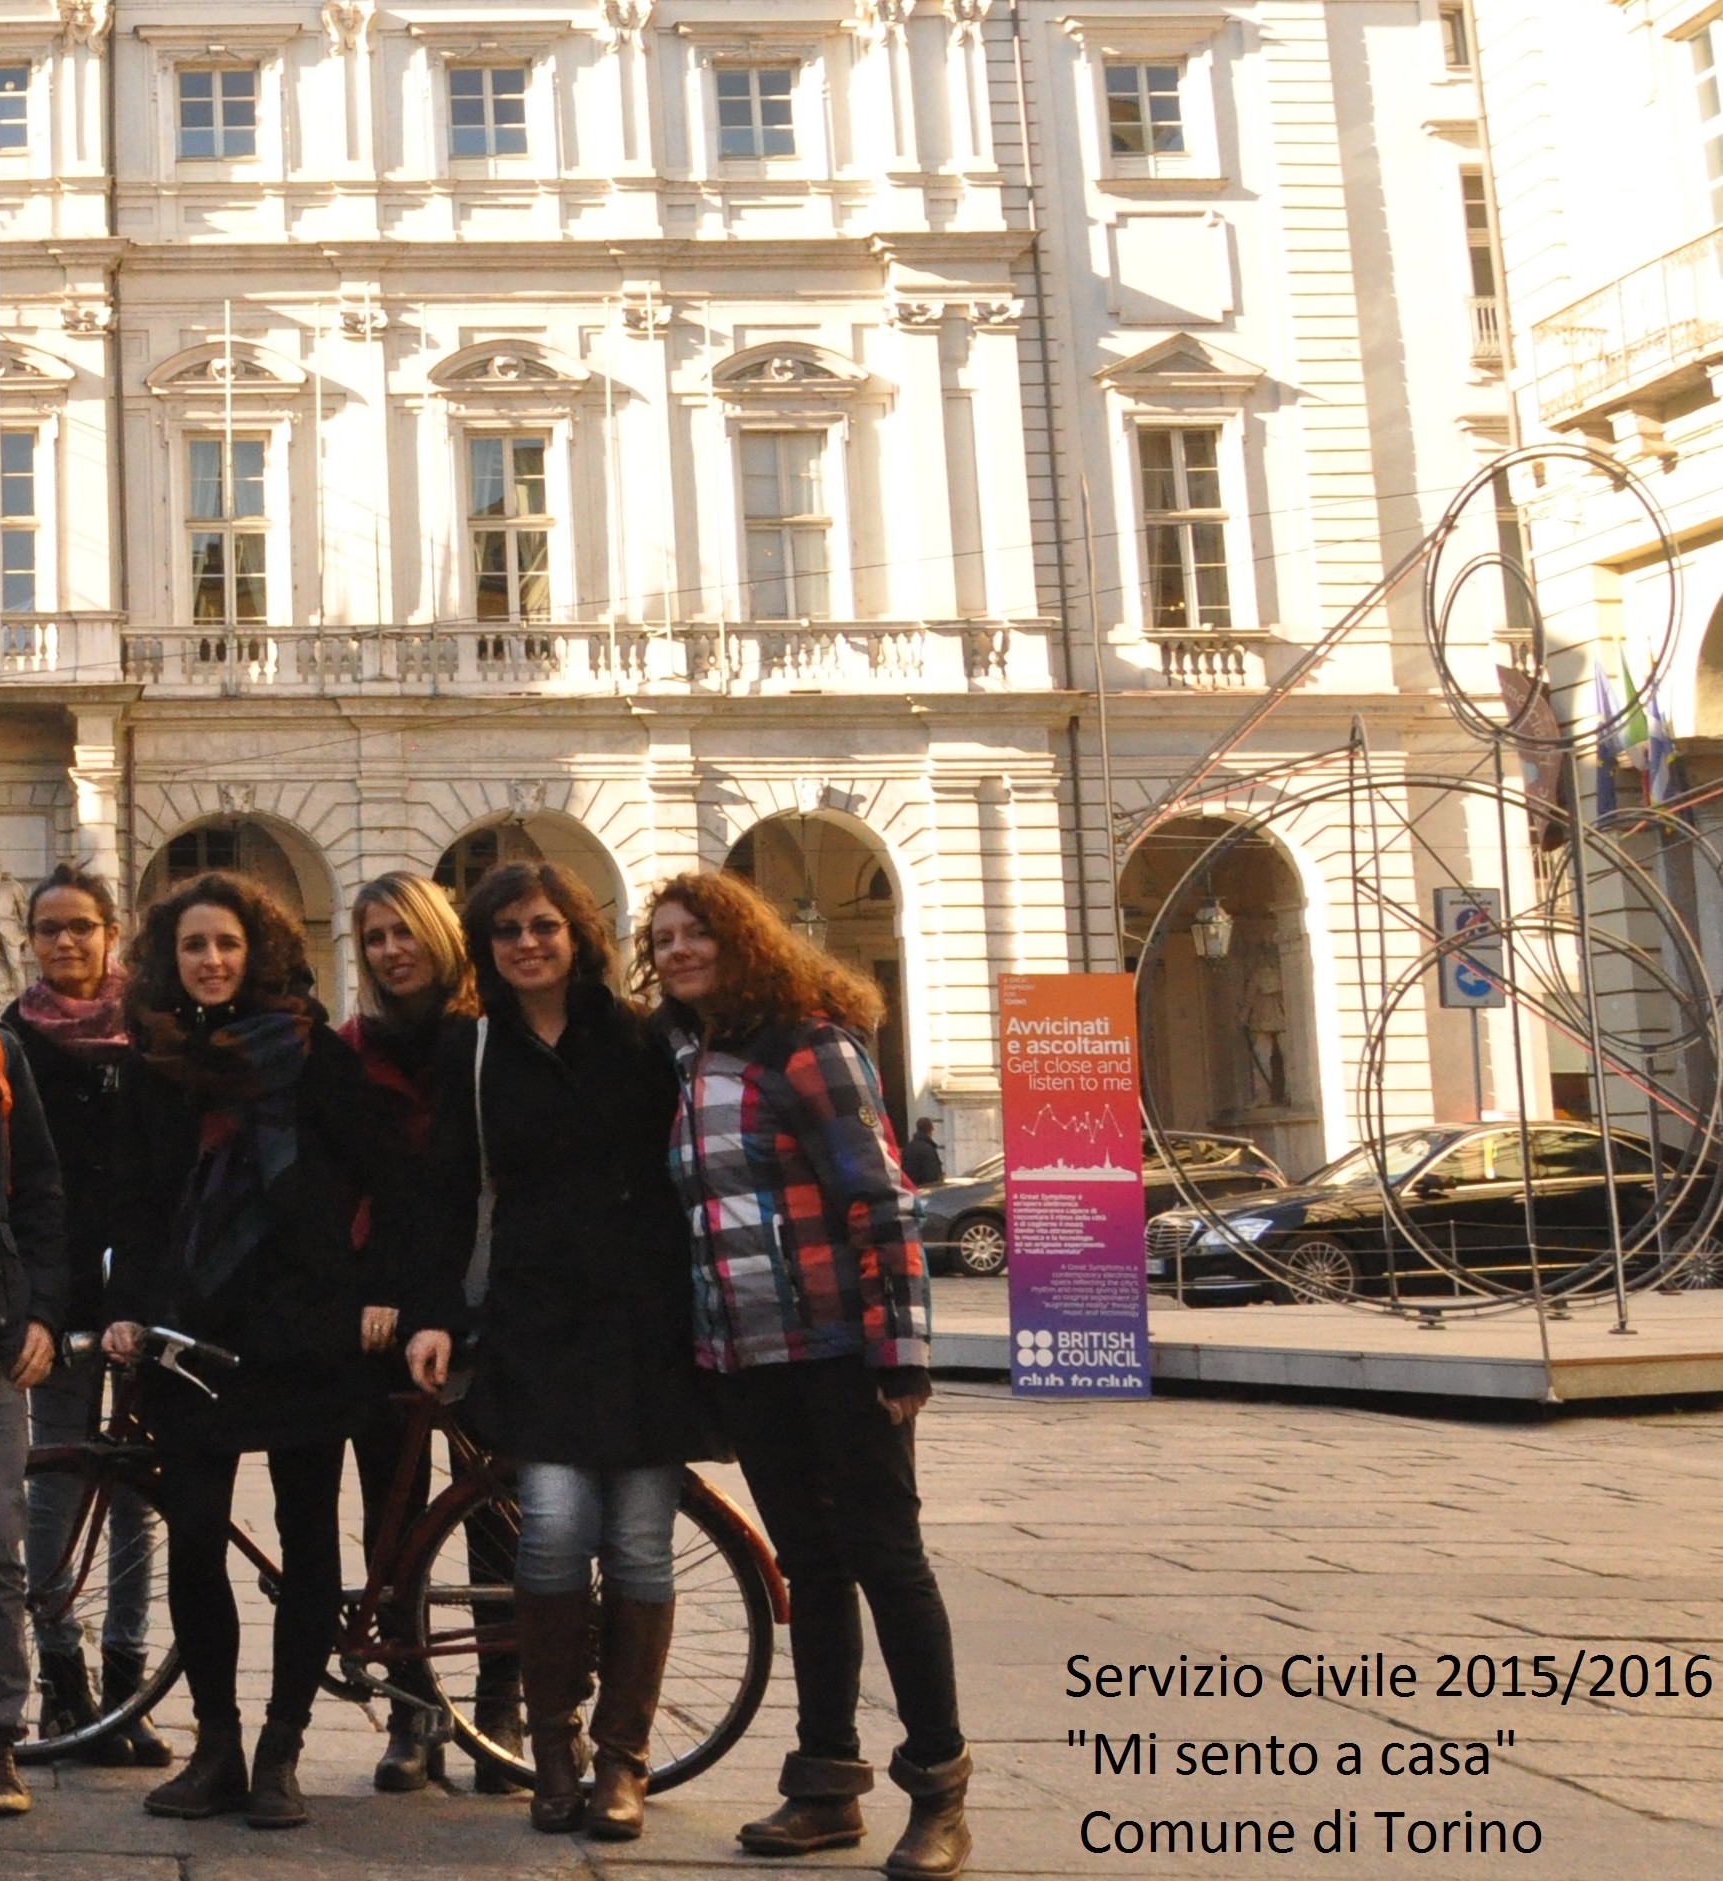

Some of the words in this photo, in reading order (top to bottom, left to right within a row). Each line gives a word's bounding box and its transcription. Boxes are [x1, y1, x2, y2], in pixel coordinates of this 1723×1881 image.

[1006, 1016, 1109, 1035] Avvicinati
[1007, 1041, 1020, 1054] e
[1026, 1036, 1130, 1055] ascoltami
[1007, 1057, 1039, 1073] Get
[1044, 1057, 1092, 1074] close
[1097, 1057, 1131, 1074] and
[1029, 1074, 1075, 1090] listen
[1079, 1074, 1098, 1091] to
[1104, 1077, 1132, 1091] me
[1058, 1331, 1135, 1349] BRITISH
[1057, 1349, 1141, 1367] COUNCIL
[1019, 1373, 1064, 1386] club
[1071, 1374, 1093, 1387] to
[1096, 1374, 1143, 1388] club
